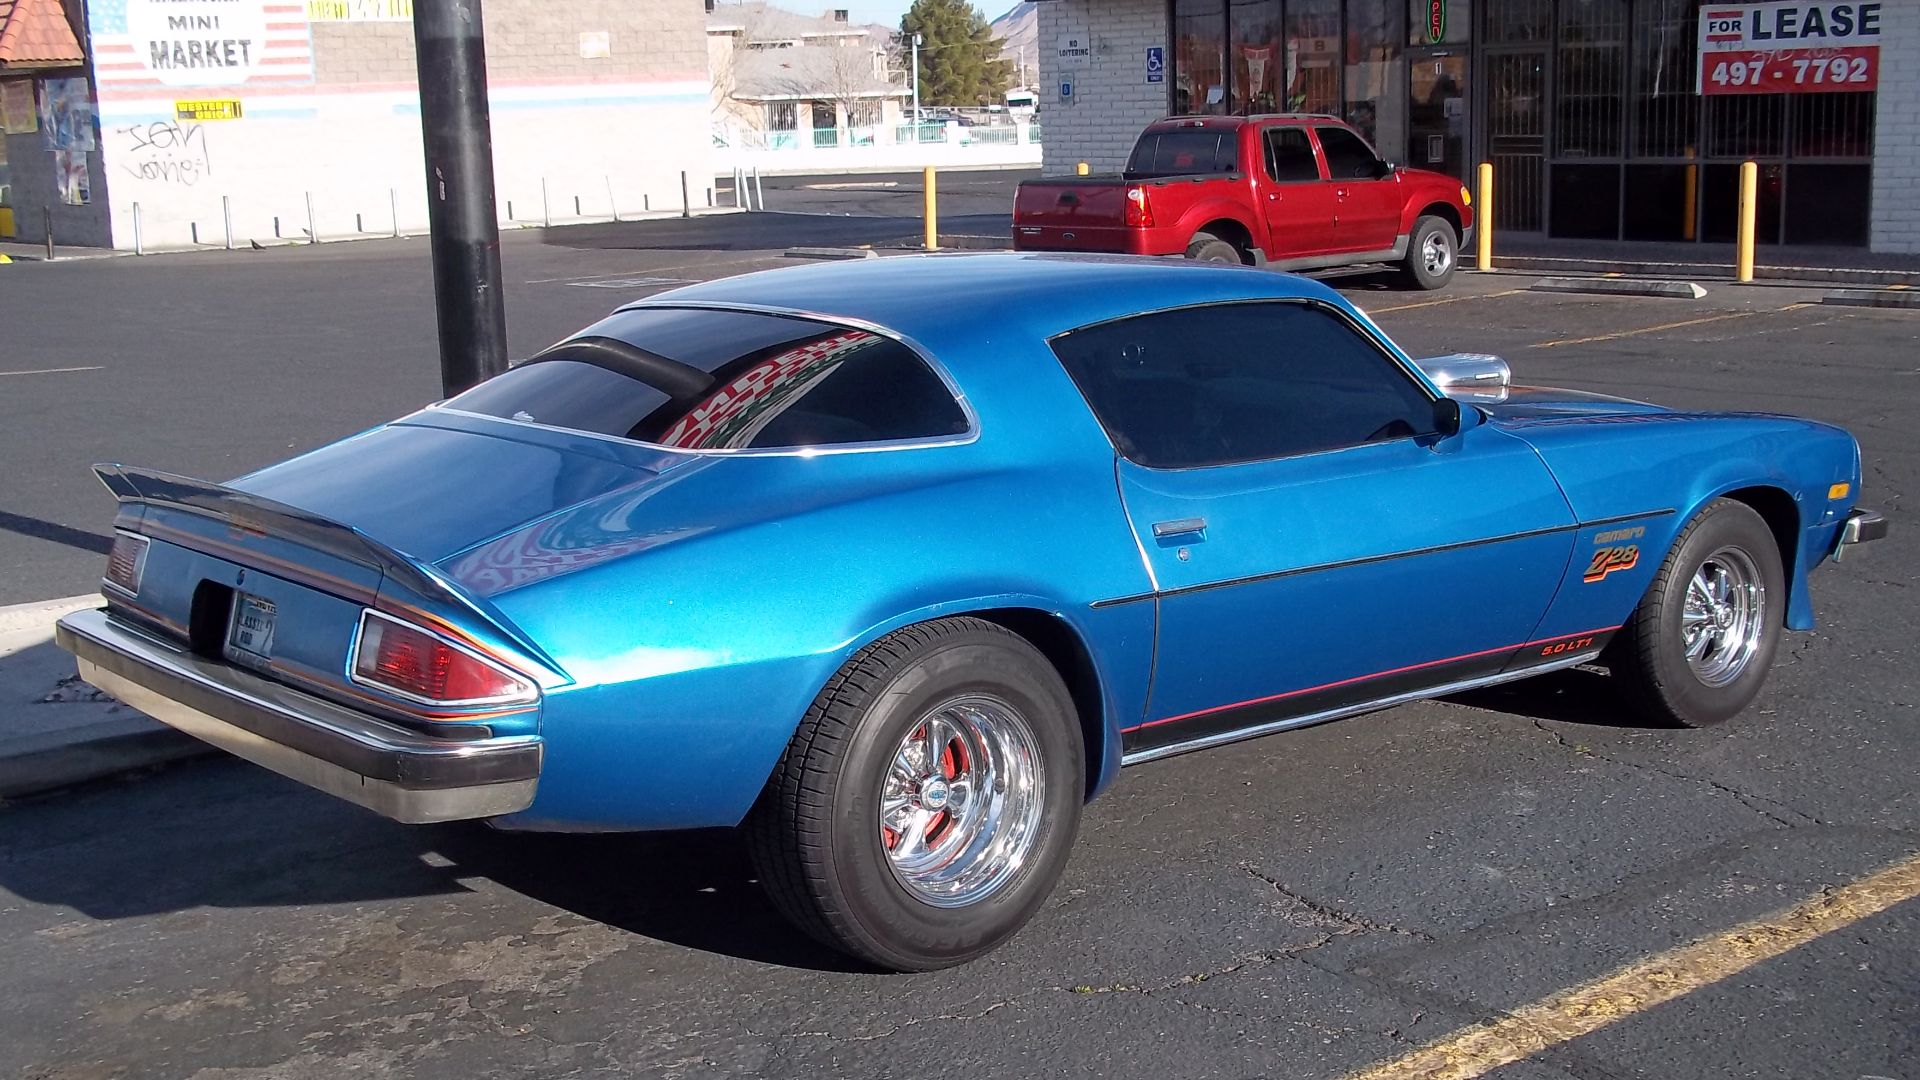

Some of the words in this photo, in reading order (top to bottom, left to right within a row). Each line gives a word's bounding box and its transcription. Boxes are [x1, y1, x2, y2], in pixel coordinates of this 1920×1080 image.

[168, 16, 220, 30] MINI
[1432, 0, 1441, 38] PEN
[1709, 20, 1742, 33] FOR
[1751, 3, 1881, 41] LEASE
[1069, 40, 1078, 48] NO
[150, 39, 252, 69] MARKET
[1059, 48, 1089, 57] LOITERING
[177, 102, 231, 111] WESTERN
[195, 110, 232, 119] UNION
[1584, 544, 1639, 581] Z28
[1541, 643, 1566, 656] 5.0
[1567, 637, 1593, 651] LT1
